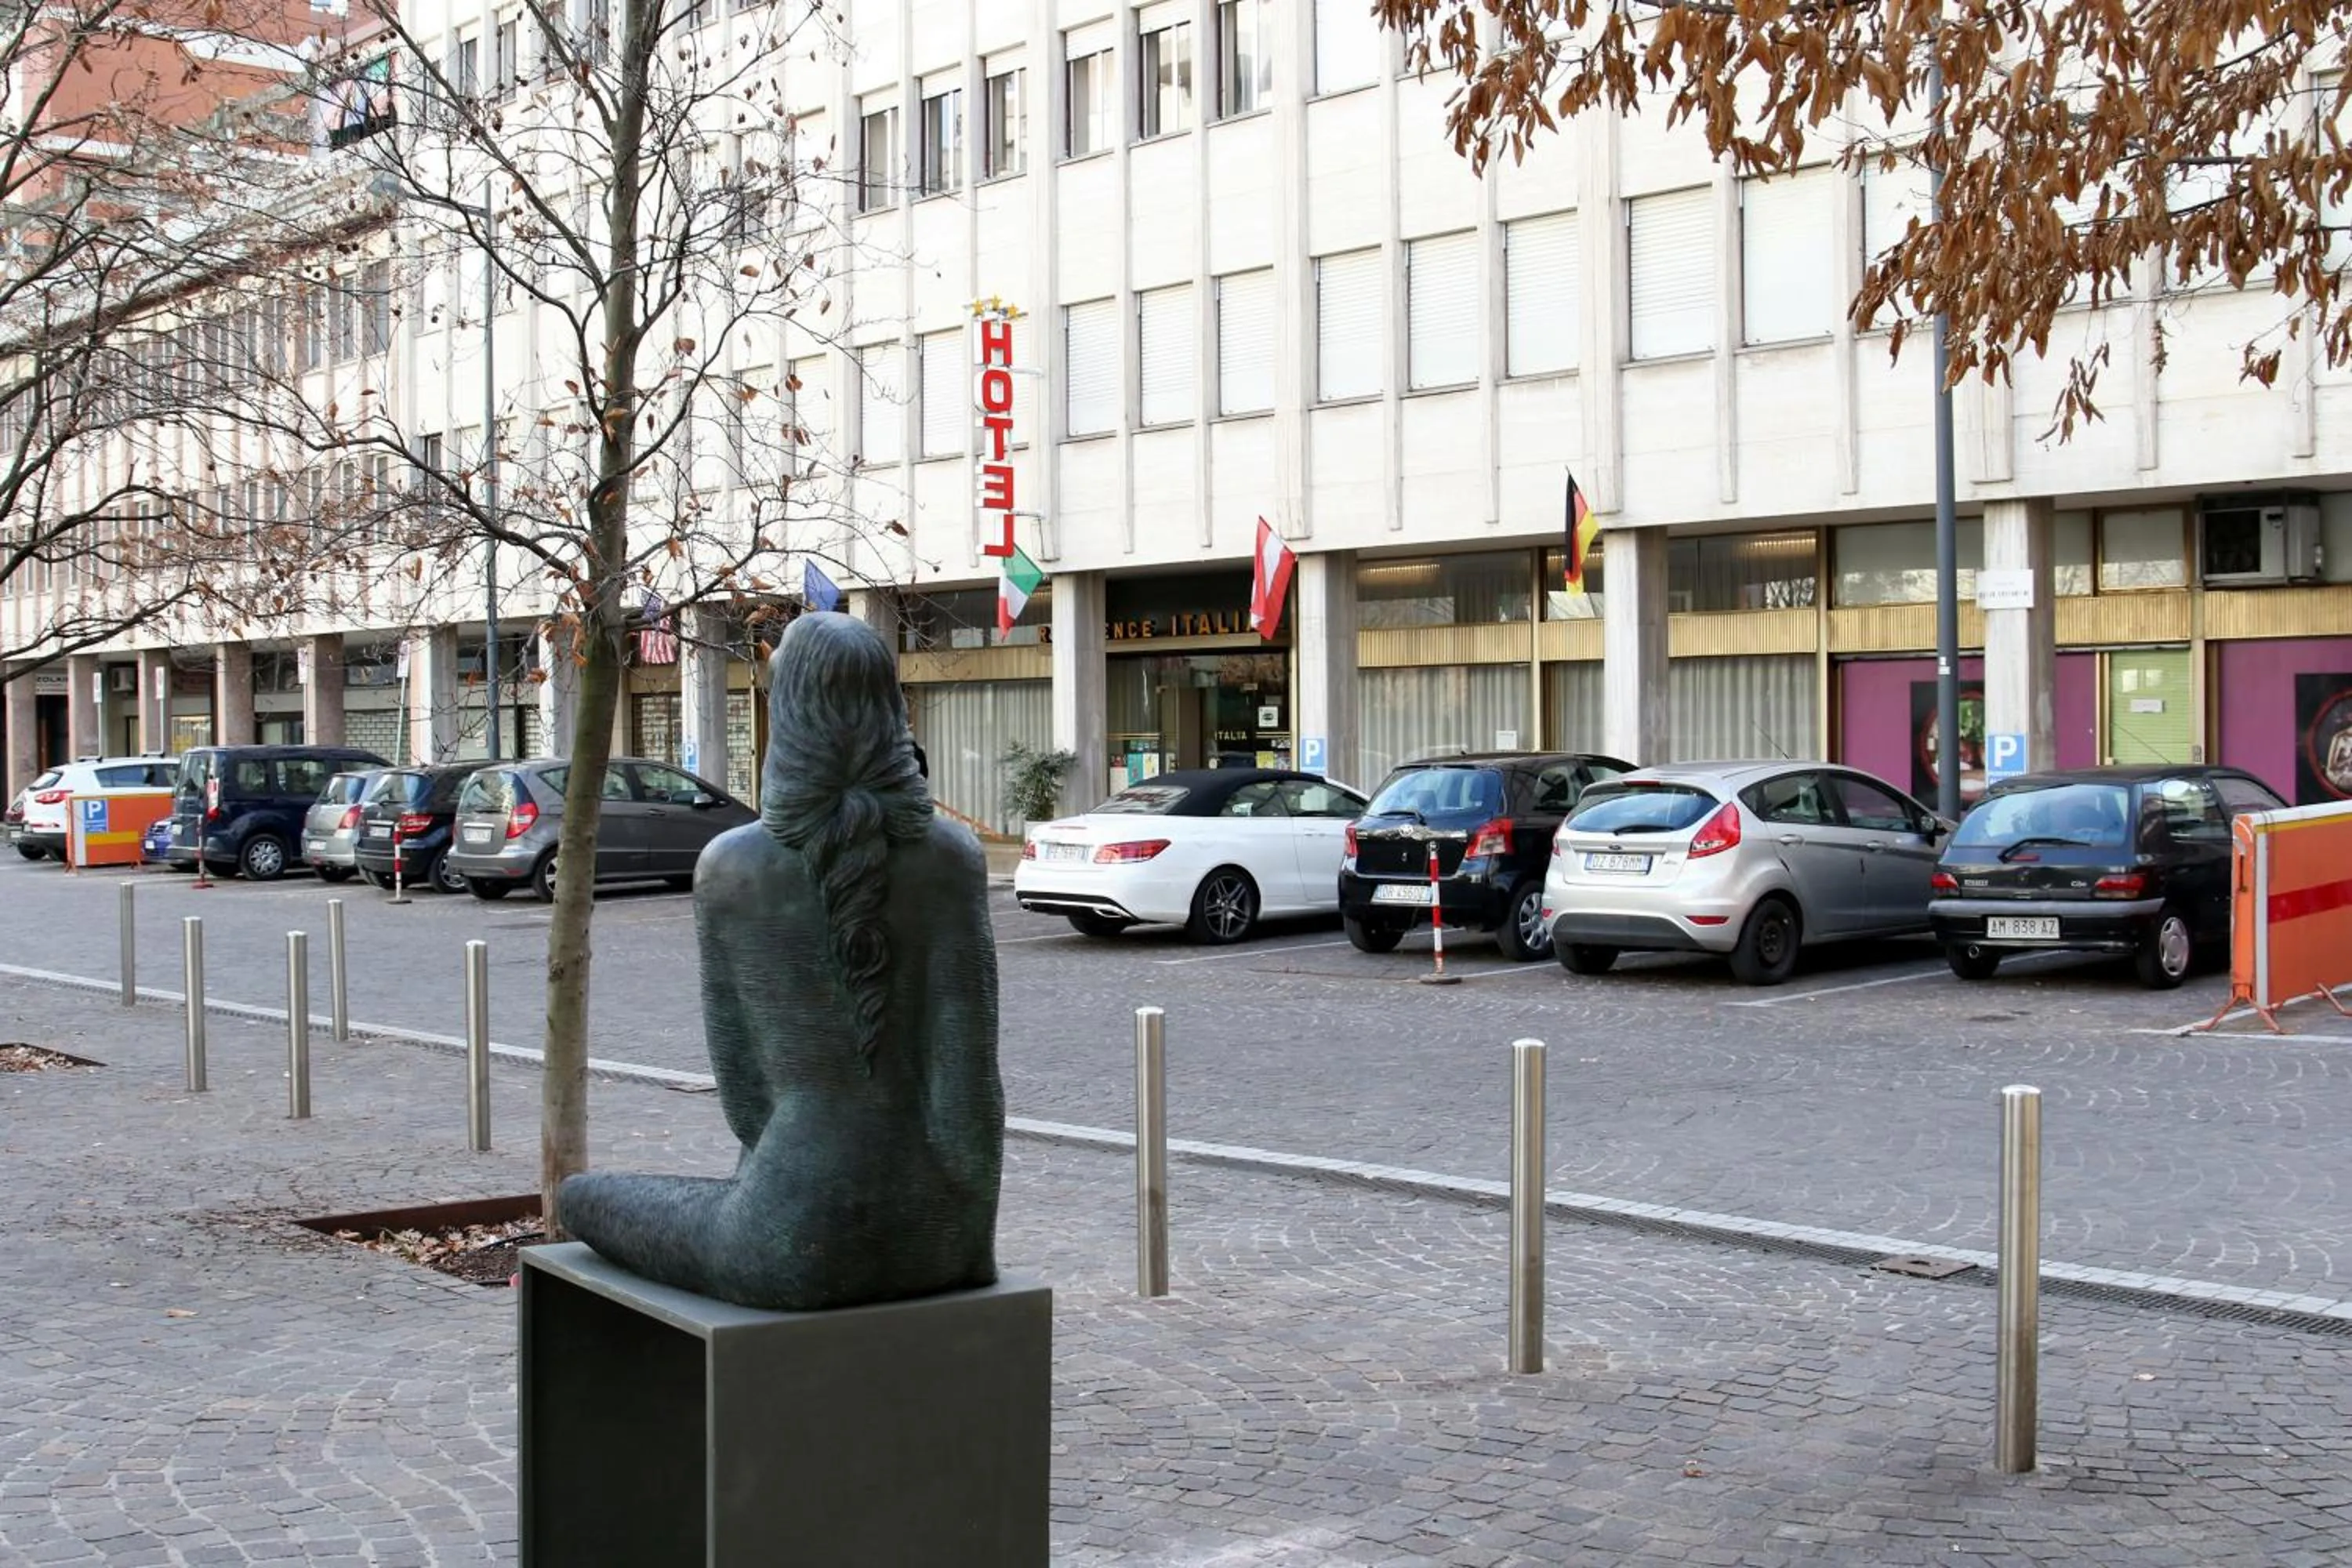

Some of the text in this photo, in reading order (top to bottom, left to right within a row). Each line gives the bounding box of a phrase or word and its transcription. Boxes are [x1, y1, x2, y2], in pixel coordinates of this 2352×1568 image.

[1214, 730, 1248, 741] ITALIA
[684, 744, 694, 763] P
[1305, 739, 1320, 766] P
[1994, 736, 2017, 768] P
[87, 800, 102, 819] P
[1991, 919, 2056, 934] AM 838 AZ
